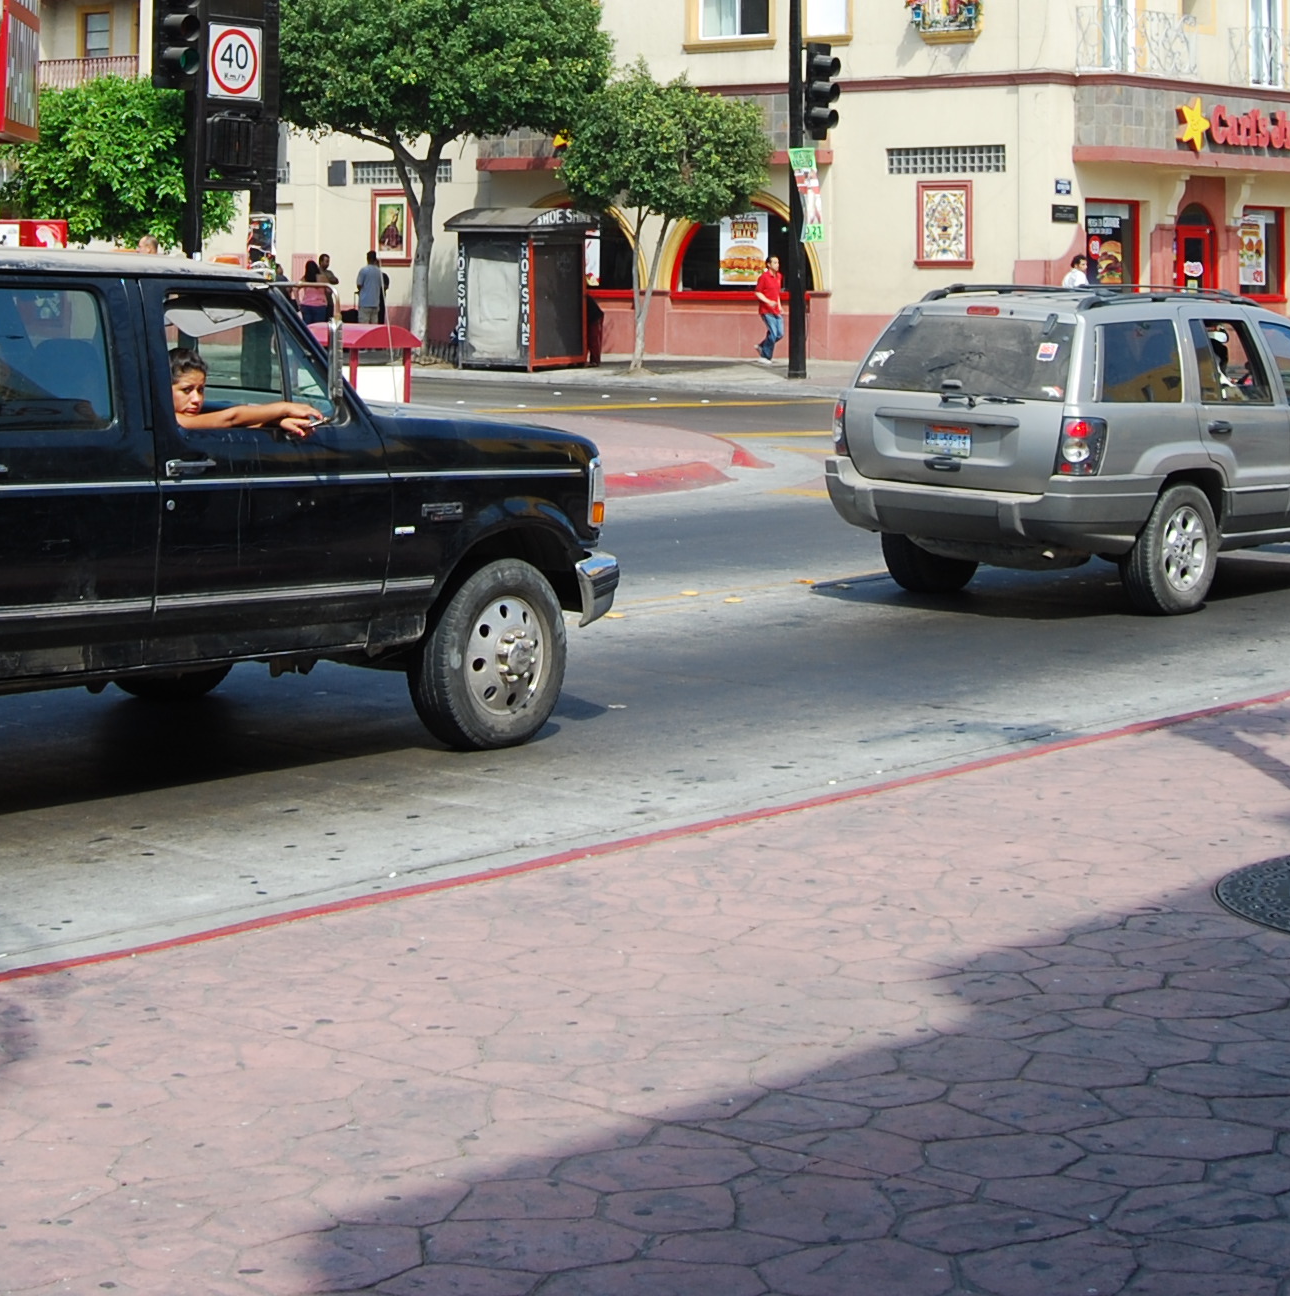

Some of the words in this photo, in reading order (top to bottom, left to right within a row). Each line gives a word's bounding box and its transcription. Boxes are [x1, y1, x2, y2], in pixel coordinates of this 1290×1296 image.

[220, 42, 249, 70] 40
[1210, 104, 1270, 148] Carl's
[537, 208, 564, 225] SHOE
[457, 242, 467, 282] HOE
[457, 284, 467, 341] SHINE
[520, 287, 531, 346] SHINE
